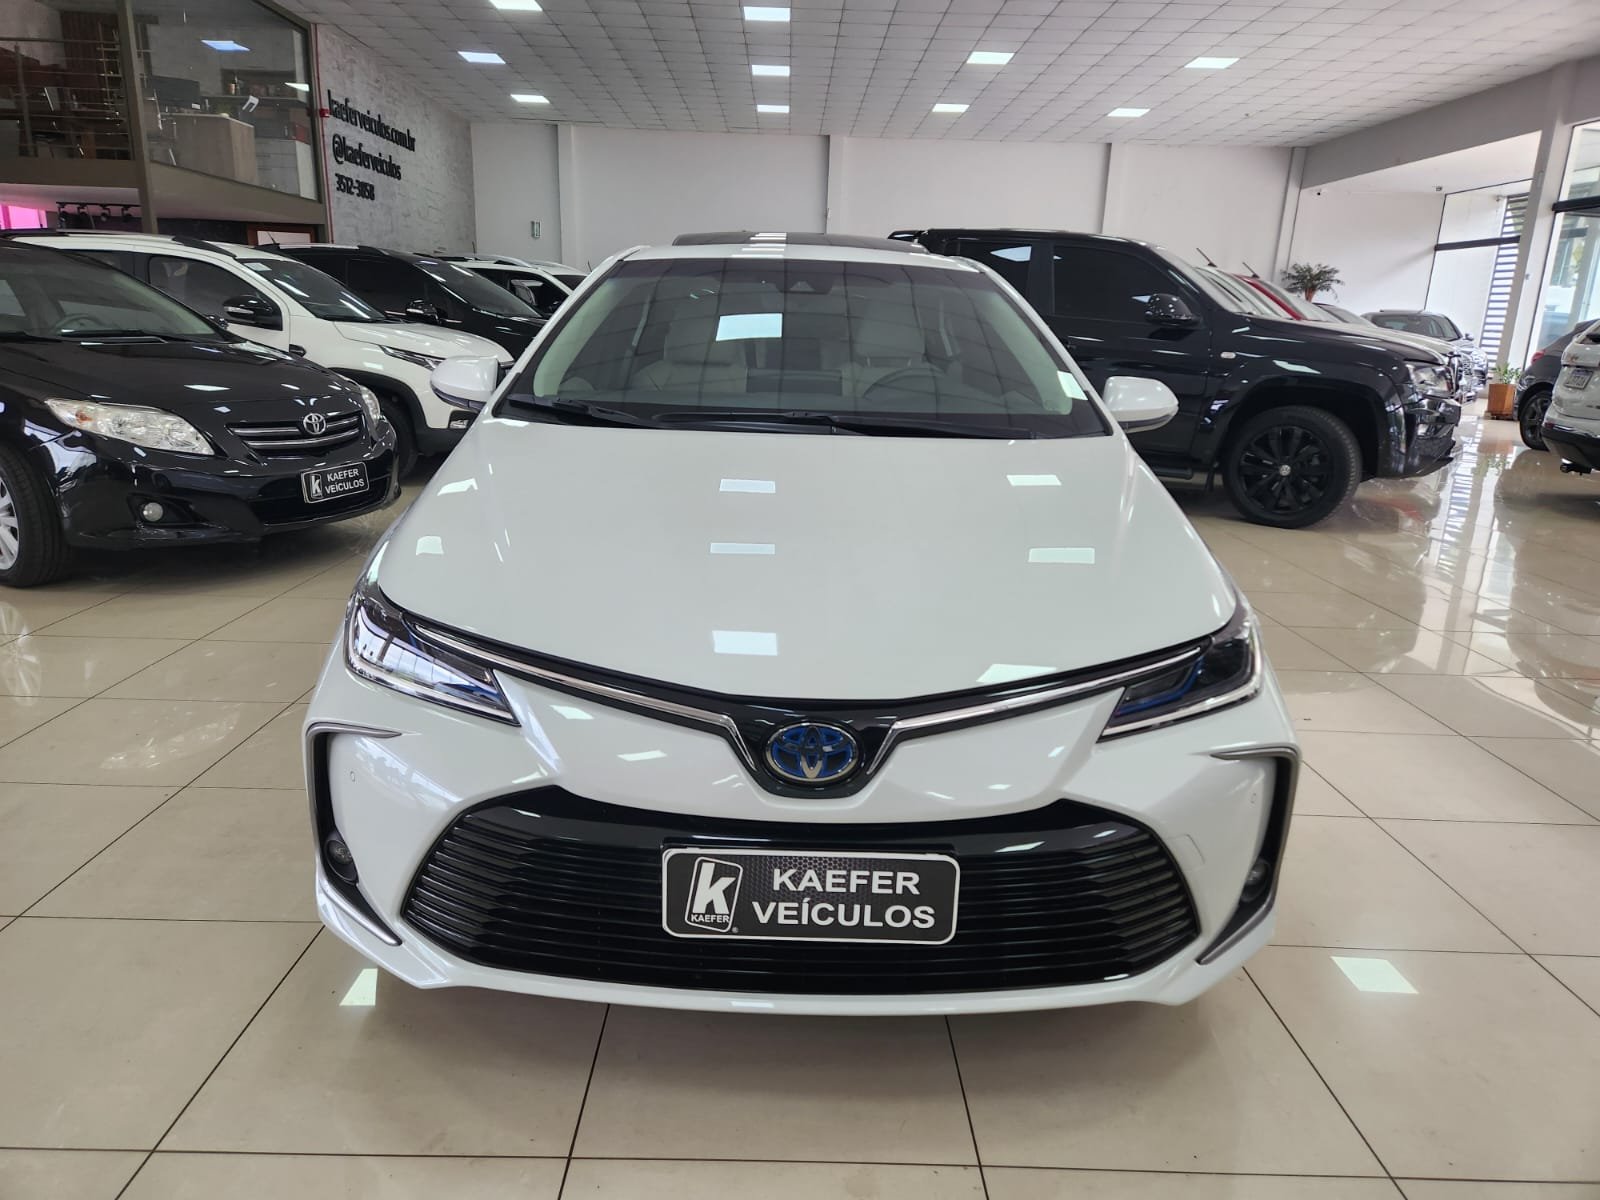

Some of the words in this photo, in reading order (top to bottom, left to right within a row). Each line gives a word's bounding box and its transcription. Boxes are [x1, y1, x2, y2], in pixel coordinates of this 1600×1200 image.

[332, 133, 401, 180] @kaeferveiculos
[327, 468, 359, 482] KAEFER
[325, 478, 365, 494] VEÍCULOS
[773, 868, 920, 895] KAEFER
[691, 914, 730, 922] KAEFER
[752, 897, 936, 929] VEÍCULOS
